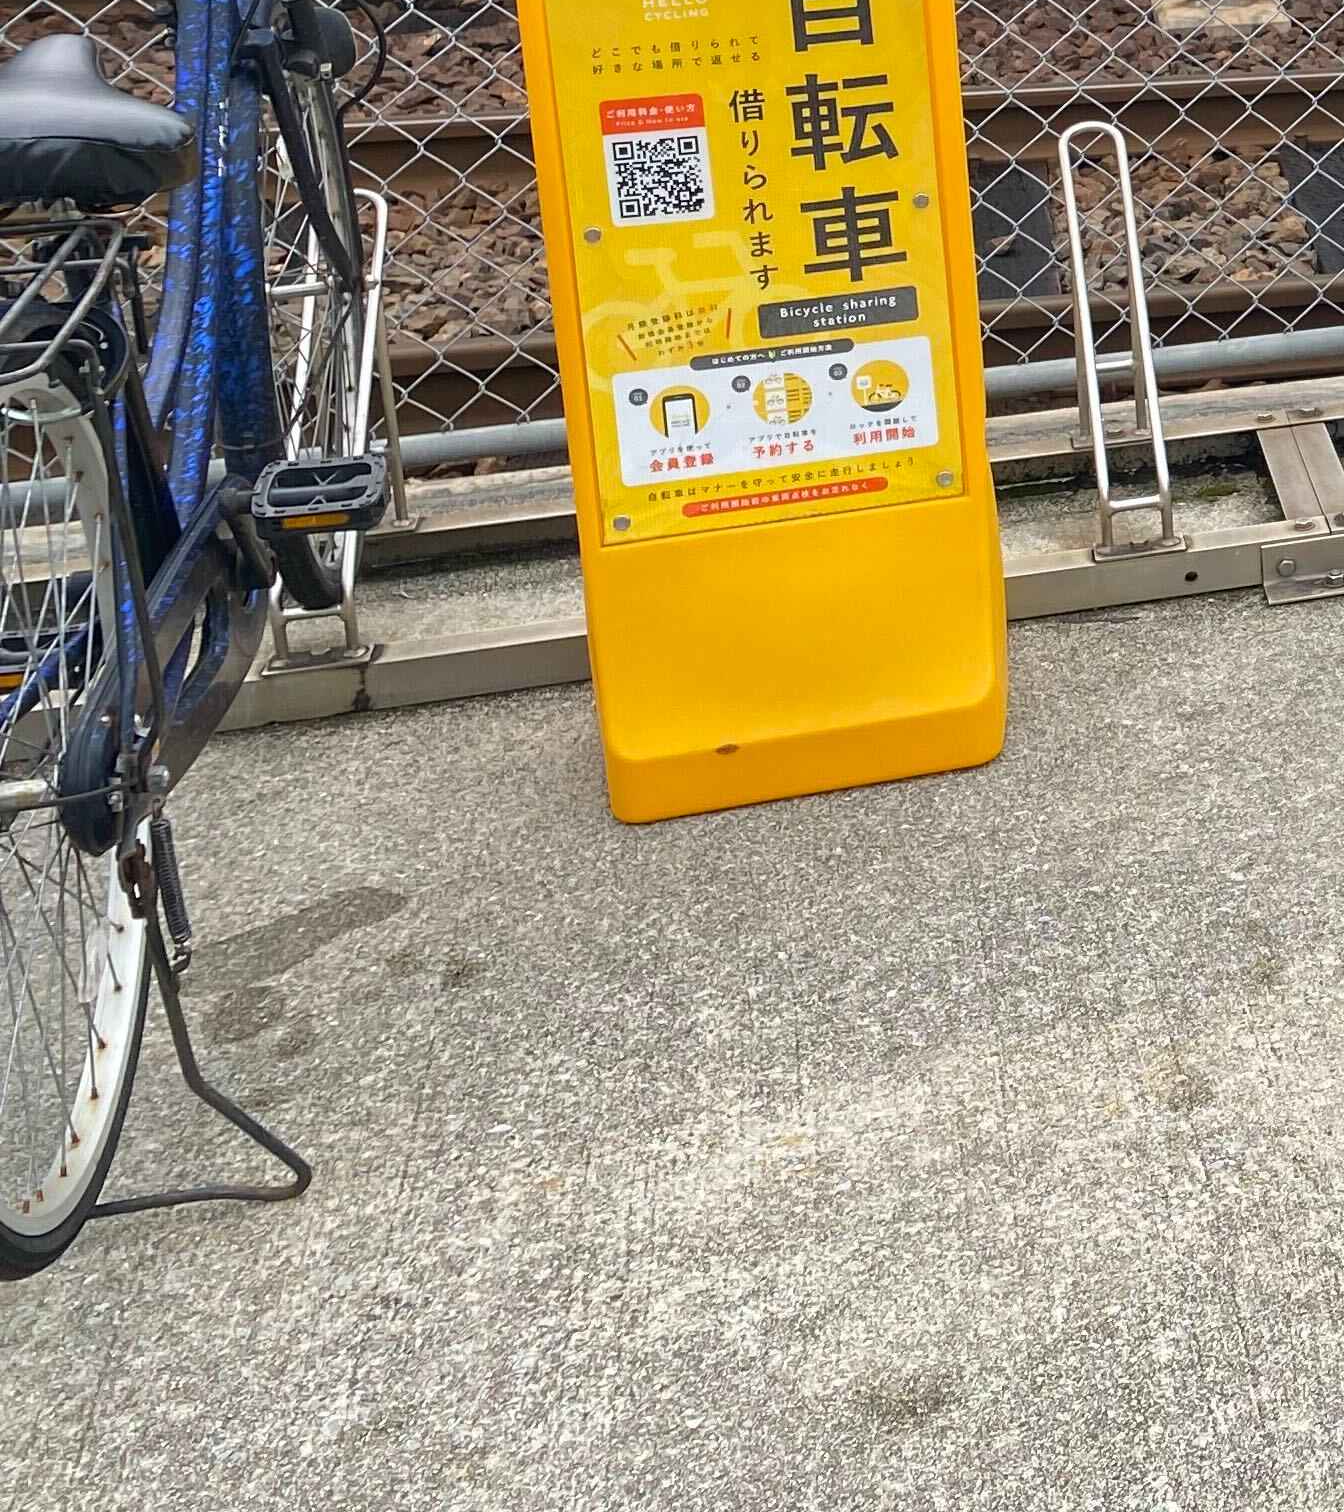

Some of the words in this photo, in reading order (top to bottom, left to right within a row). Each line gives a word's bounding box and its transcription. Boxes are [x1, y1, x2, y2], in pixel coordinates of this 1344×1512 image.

[644, 8, 709, 21] CYCLING
[591, 35, 760, 59] どこでも借りられて
[592, 51, 760, 75] 好きな場所で返せる
[728, 89, 778, 289] 借りられます
[780, 303, 833, 319] Bicycle
[842, 294, 897, 314] sharing
[813, 313, 866, 329] station
[712, 352, 765, 365] はじめての方へ
[853, 426, 916, 445] 利用開始
[753, 440, 815, 458] 予約する
[650, 452, 714, 473] 会員登録
[648, 457, 916, 503] 自転車はマナーを守って安全に走行しましょう
